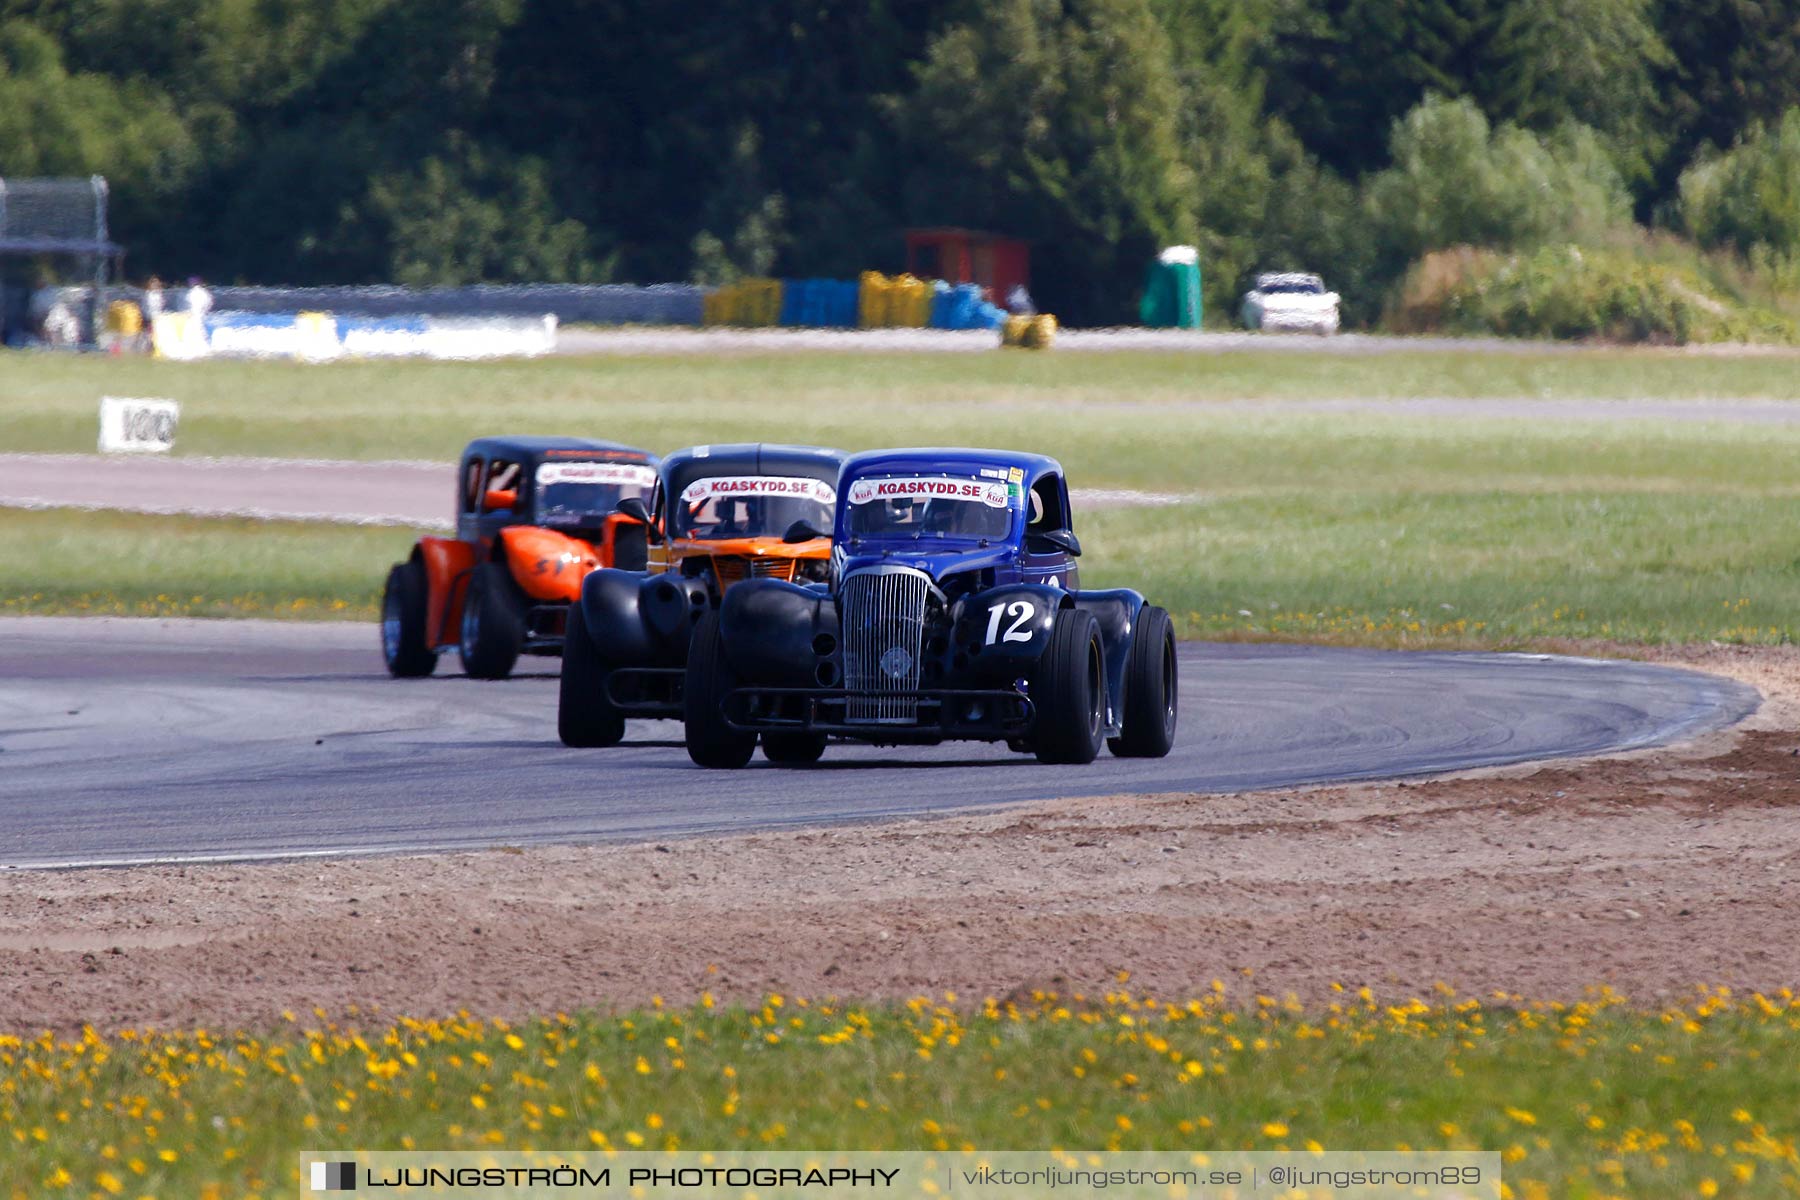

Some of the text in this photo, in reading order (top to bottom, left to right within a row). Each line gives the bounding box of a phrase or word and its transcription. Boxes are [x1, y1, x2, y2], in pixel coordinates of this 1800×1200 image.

[712, 481, 808, 493] KGASKYDD.SE
[878, 482, 981, 497] KGASKYDD.SE
[985, 601, 1035, 646] 12
